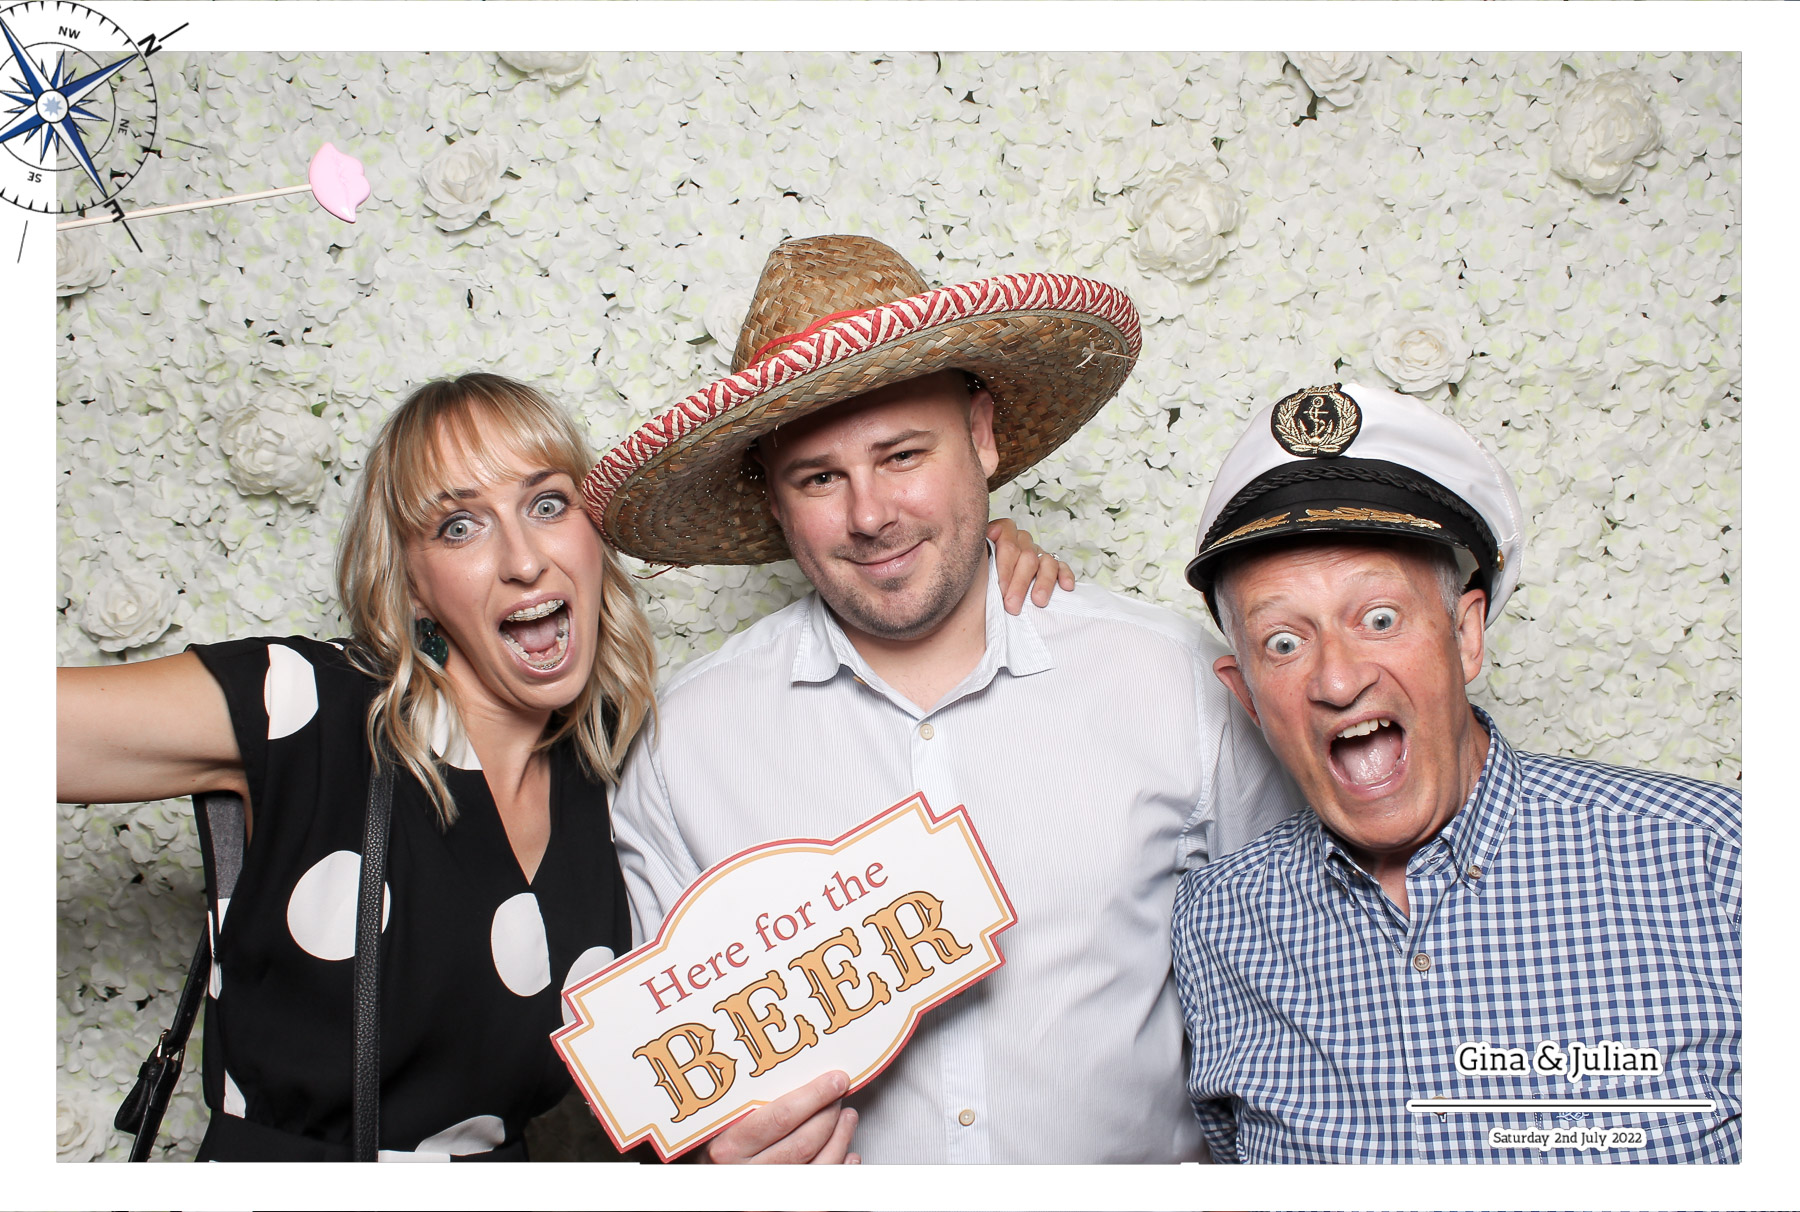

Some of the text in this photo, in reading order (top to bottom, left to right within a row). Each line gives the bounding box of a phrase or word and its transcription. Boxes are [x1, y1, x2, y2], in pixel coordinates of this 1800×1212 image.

[632, 890, 973, 1124] BEER
[640, 862, 888, 1014] Here for the
